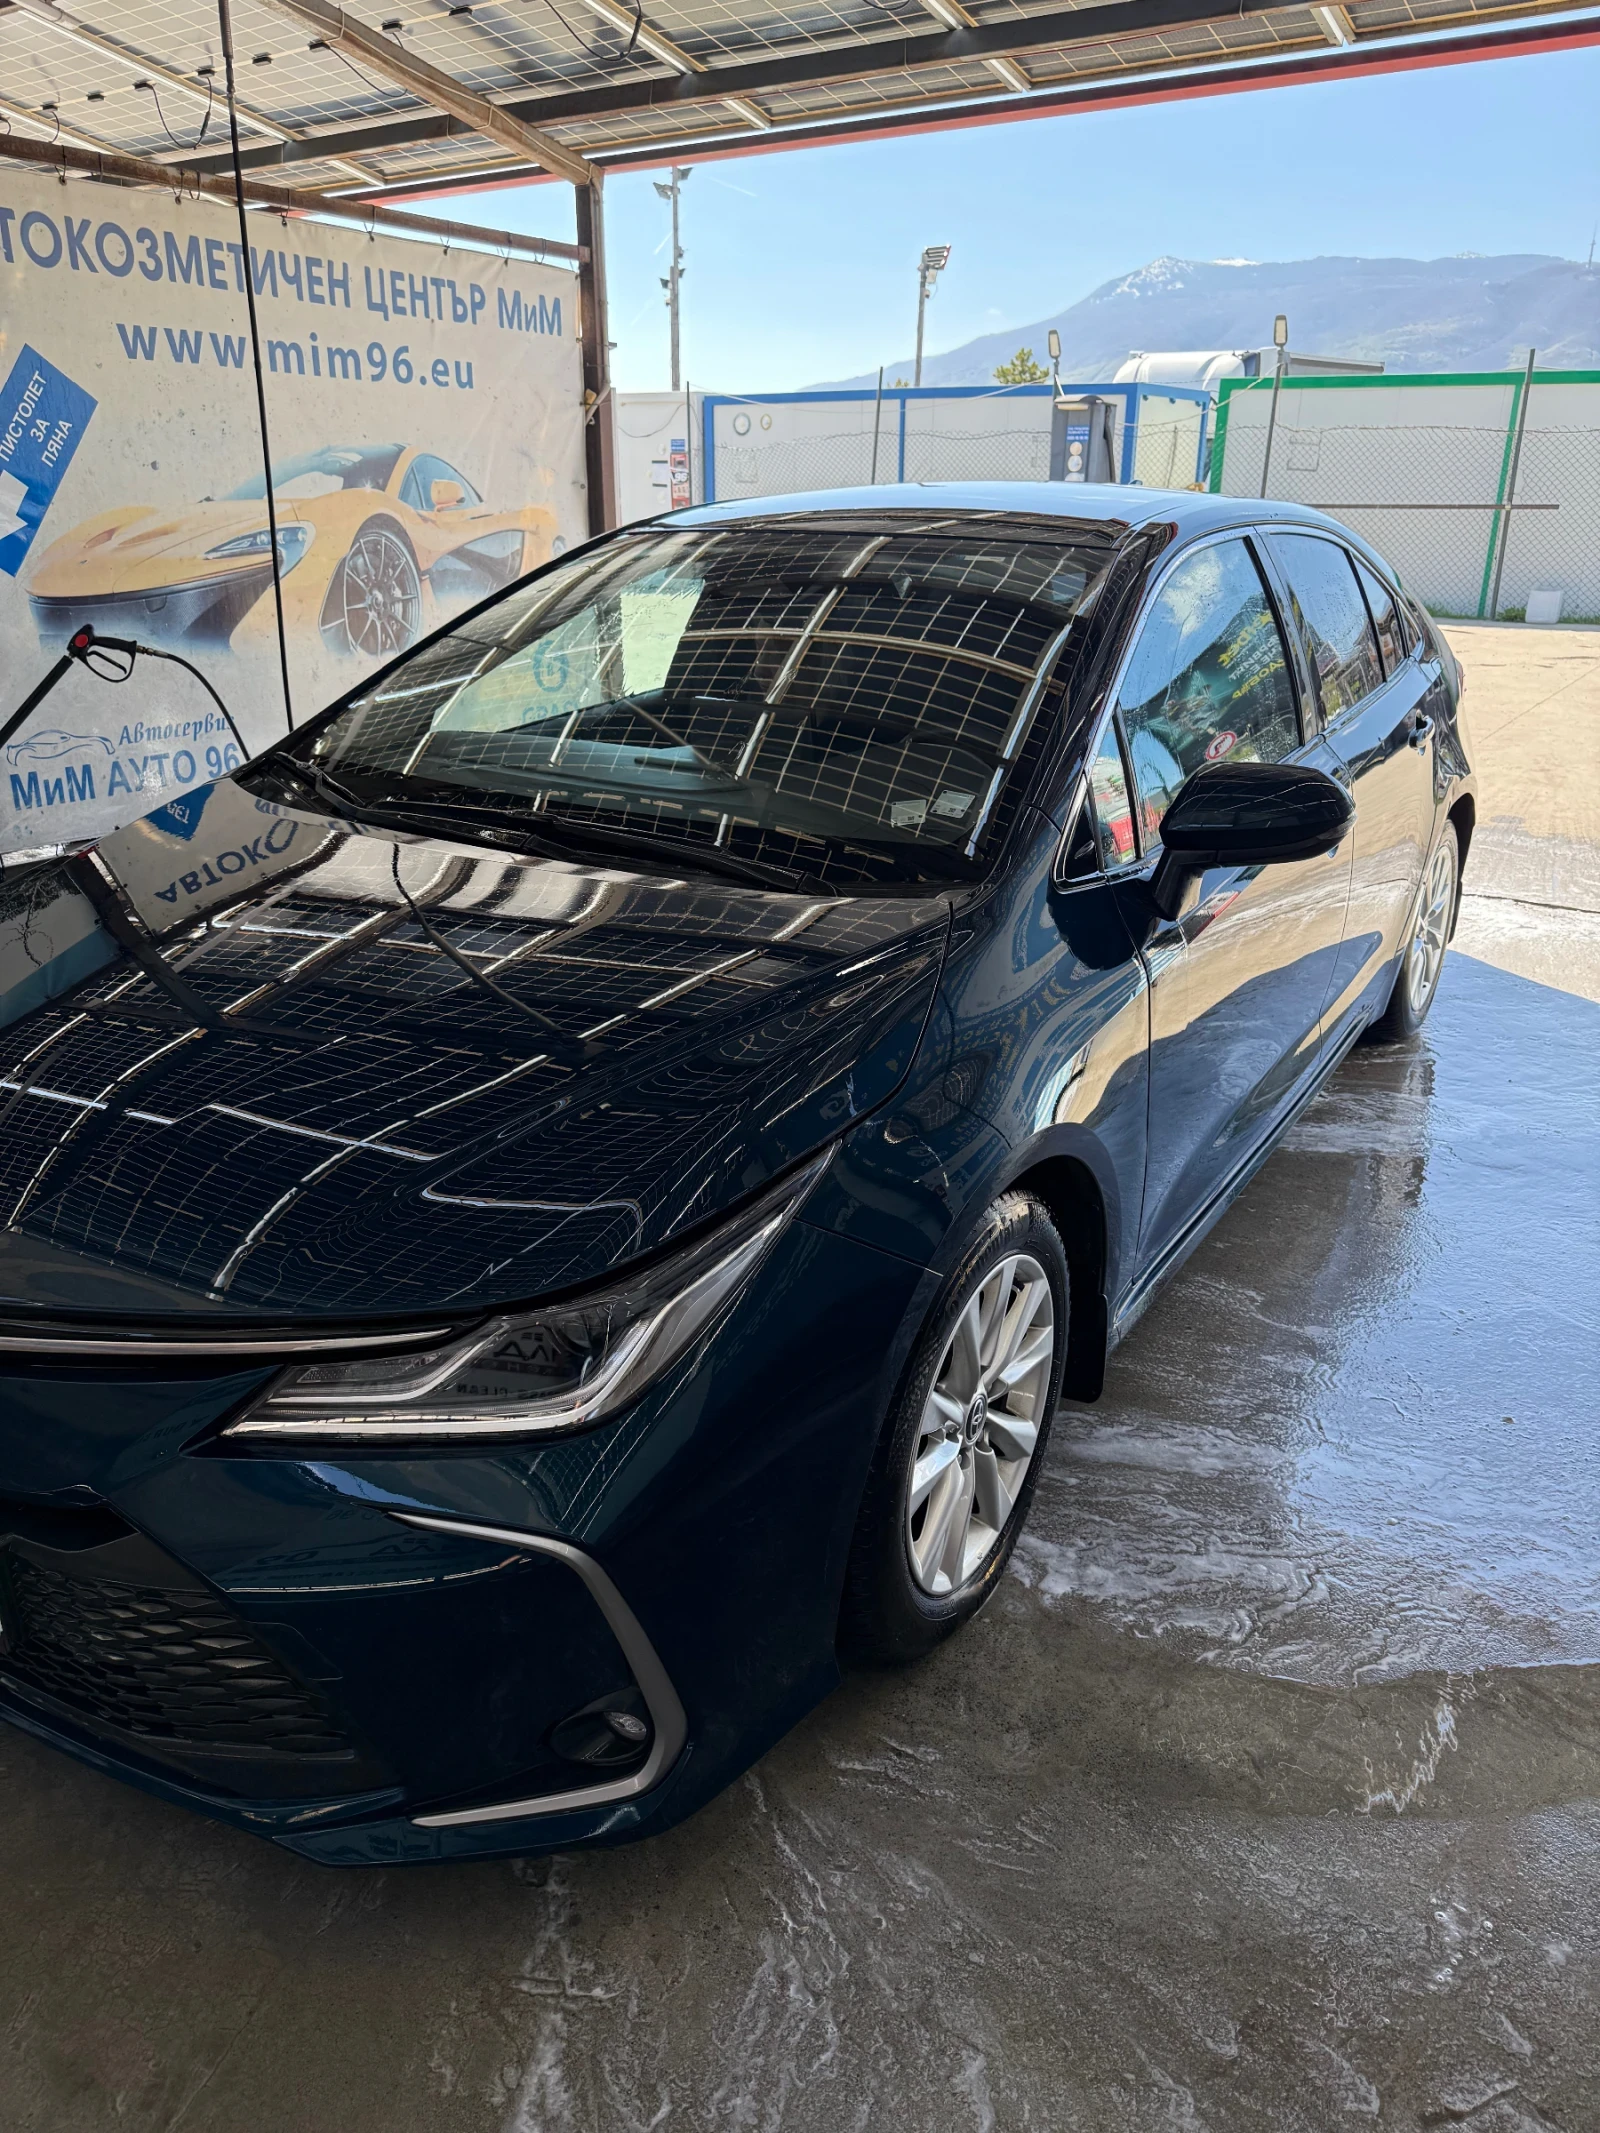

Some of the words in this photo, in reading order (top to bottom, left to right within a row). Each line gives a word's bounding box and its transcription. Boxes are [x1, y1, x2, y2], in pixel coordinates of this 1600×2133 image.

[364, 266, 486, 325] ЦЕНТЪР
[497, 287, 562, 336] МиМ
[116, 322, 474, 389] wwwmim96.eu
[0, 370, 47, 462] ПИСТОЛЕТ
[30, 418, 51, 443] ЗА
[41, 420, 73, 468] ПЯНА
[9, 764, 96, 811] МиМ
[107, 749, 197, 797] АУТО
[205, 742, 240, 779] 96
